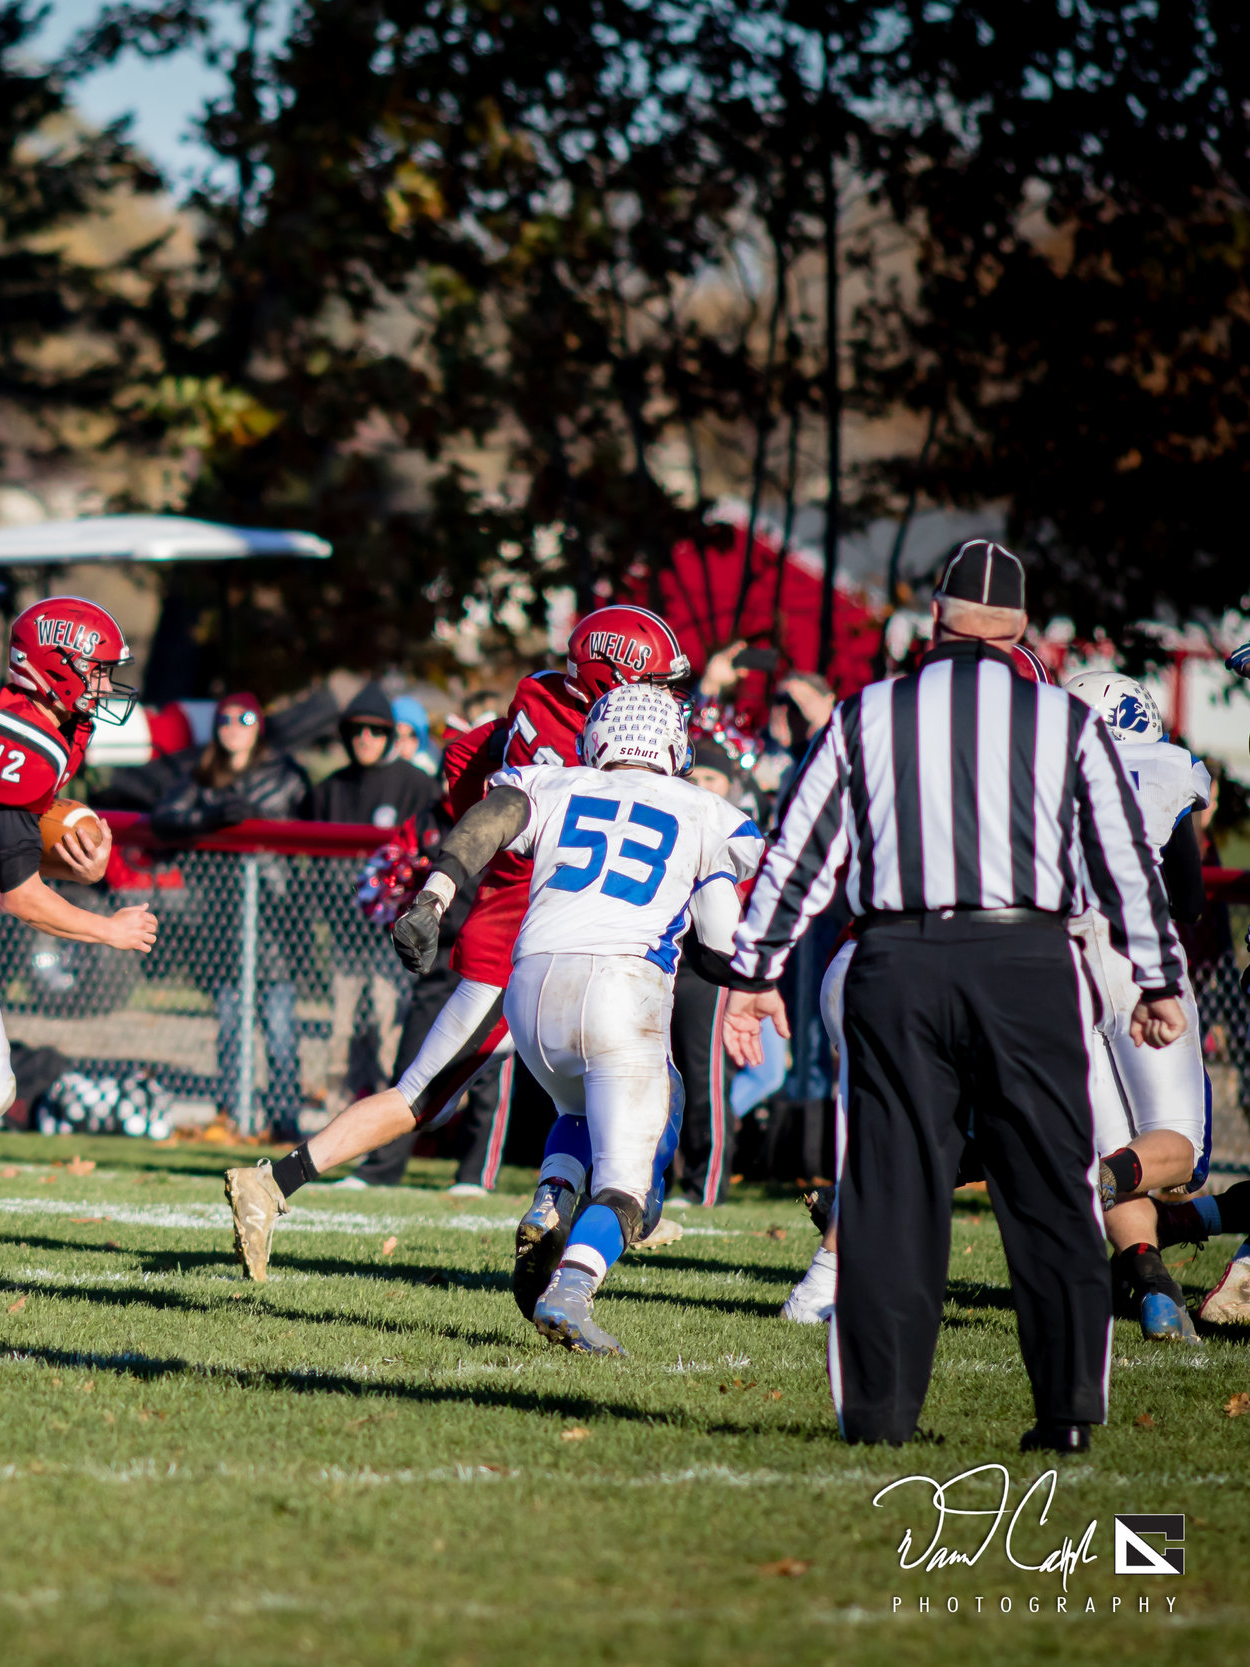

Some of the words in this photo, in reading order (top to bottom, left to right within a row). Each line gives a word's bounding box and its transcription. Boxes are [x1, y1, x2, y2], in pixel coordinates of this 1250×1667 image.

[38, 618, 101, 657] WELLS
[590, 631, 652, 672] WELLS
[545, 794, 679, 907] 53
